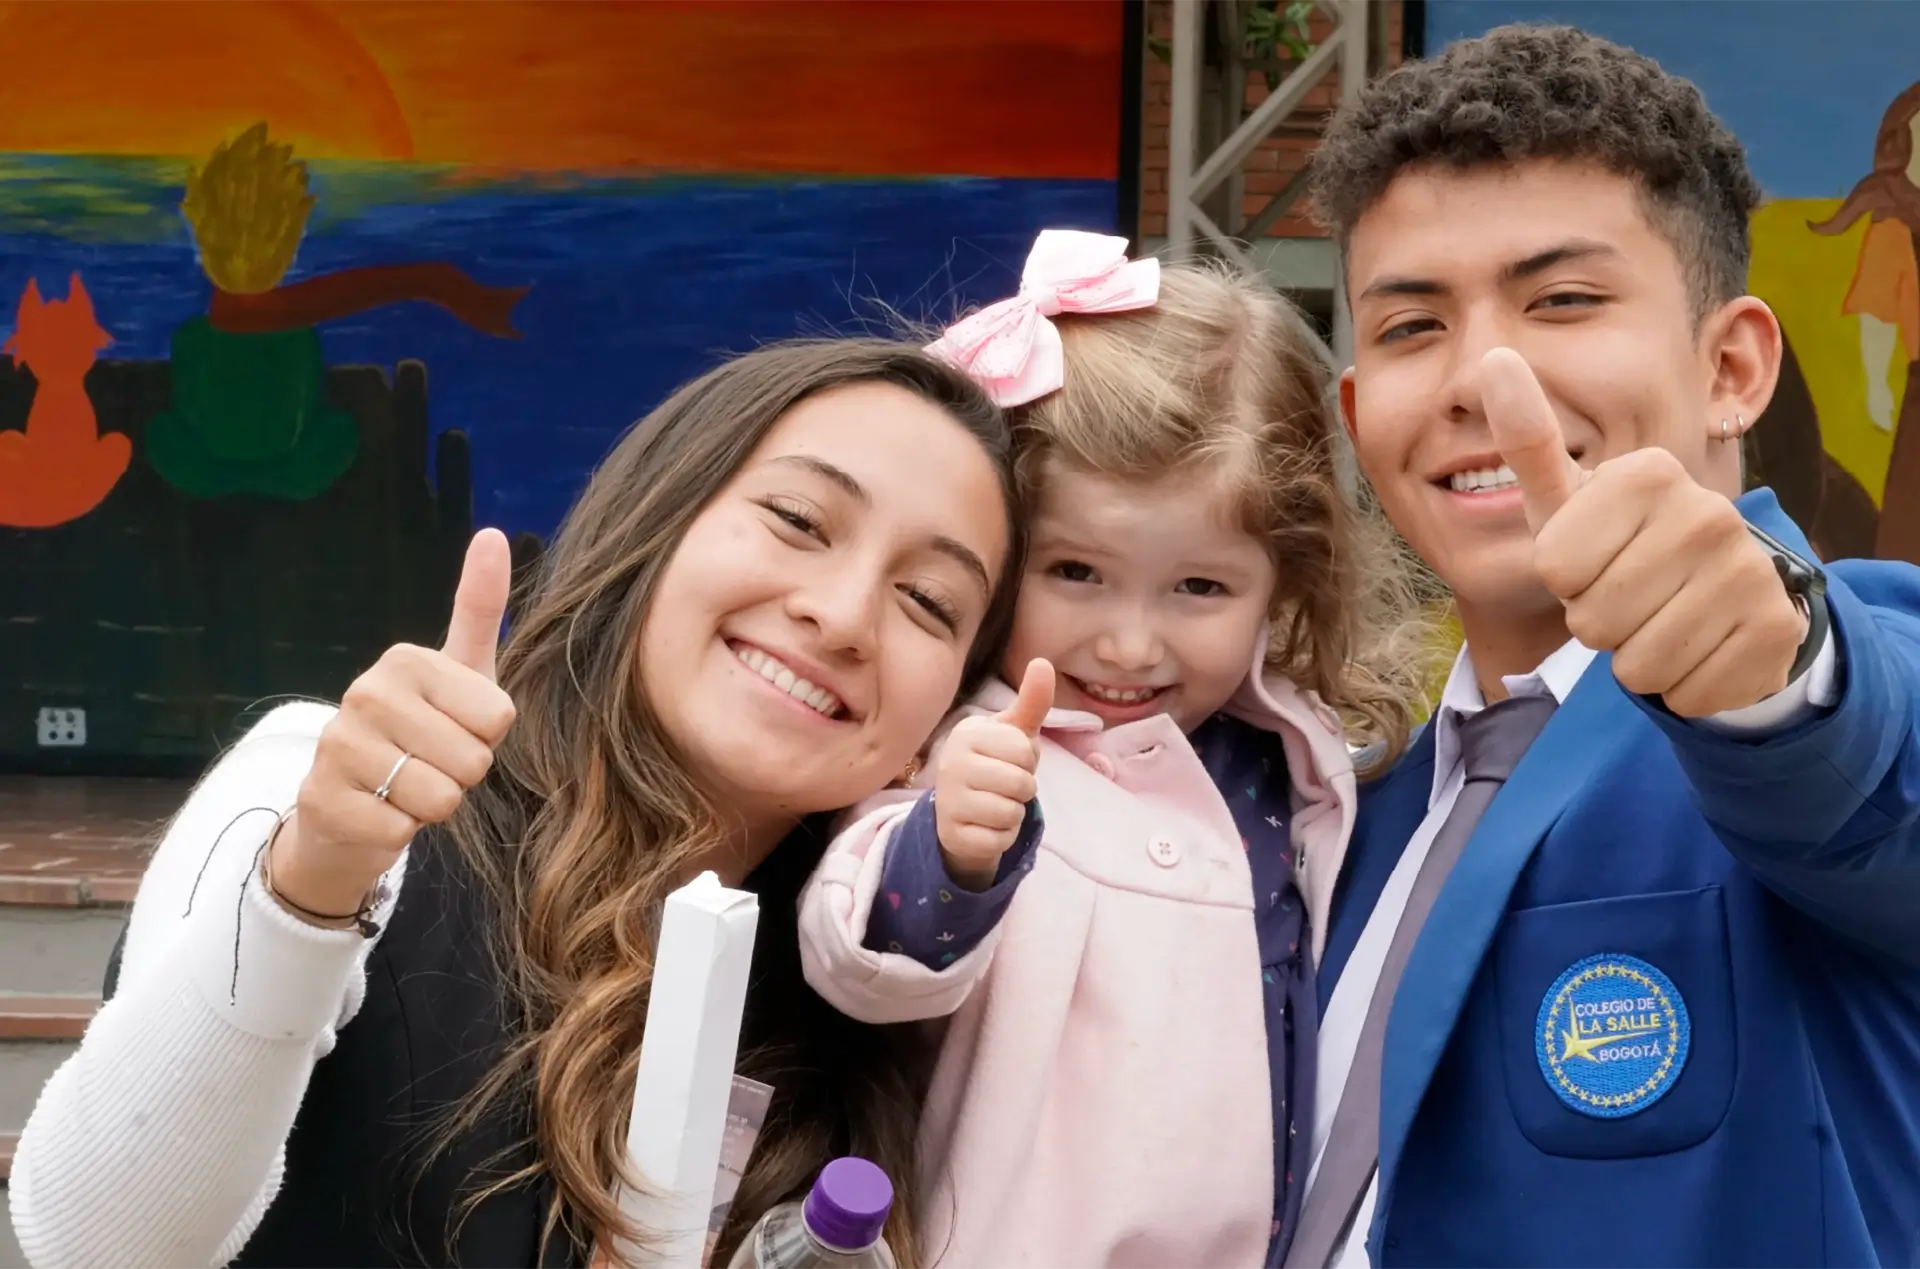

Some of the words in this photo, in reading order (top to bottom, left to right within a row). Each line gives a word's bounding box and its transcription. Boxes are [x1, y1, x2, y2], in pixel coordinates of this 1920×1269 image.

[1575, 999, 1634, 1017] COLEGIO
[1638, 998, 1656, 1010] DE
[1580, 1020, 1602, 1034] LA
[1607, 1014, 1661, 1031] SALLE
[1599, 1040, 1661, 1061] BOGOTÁ
